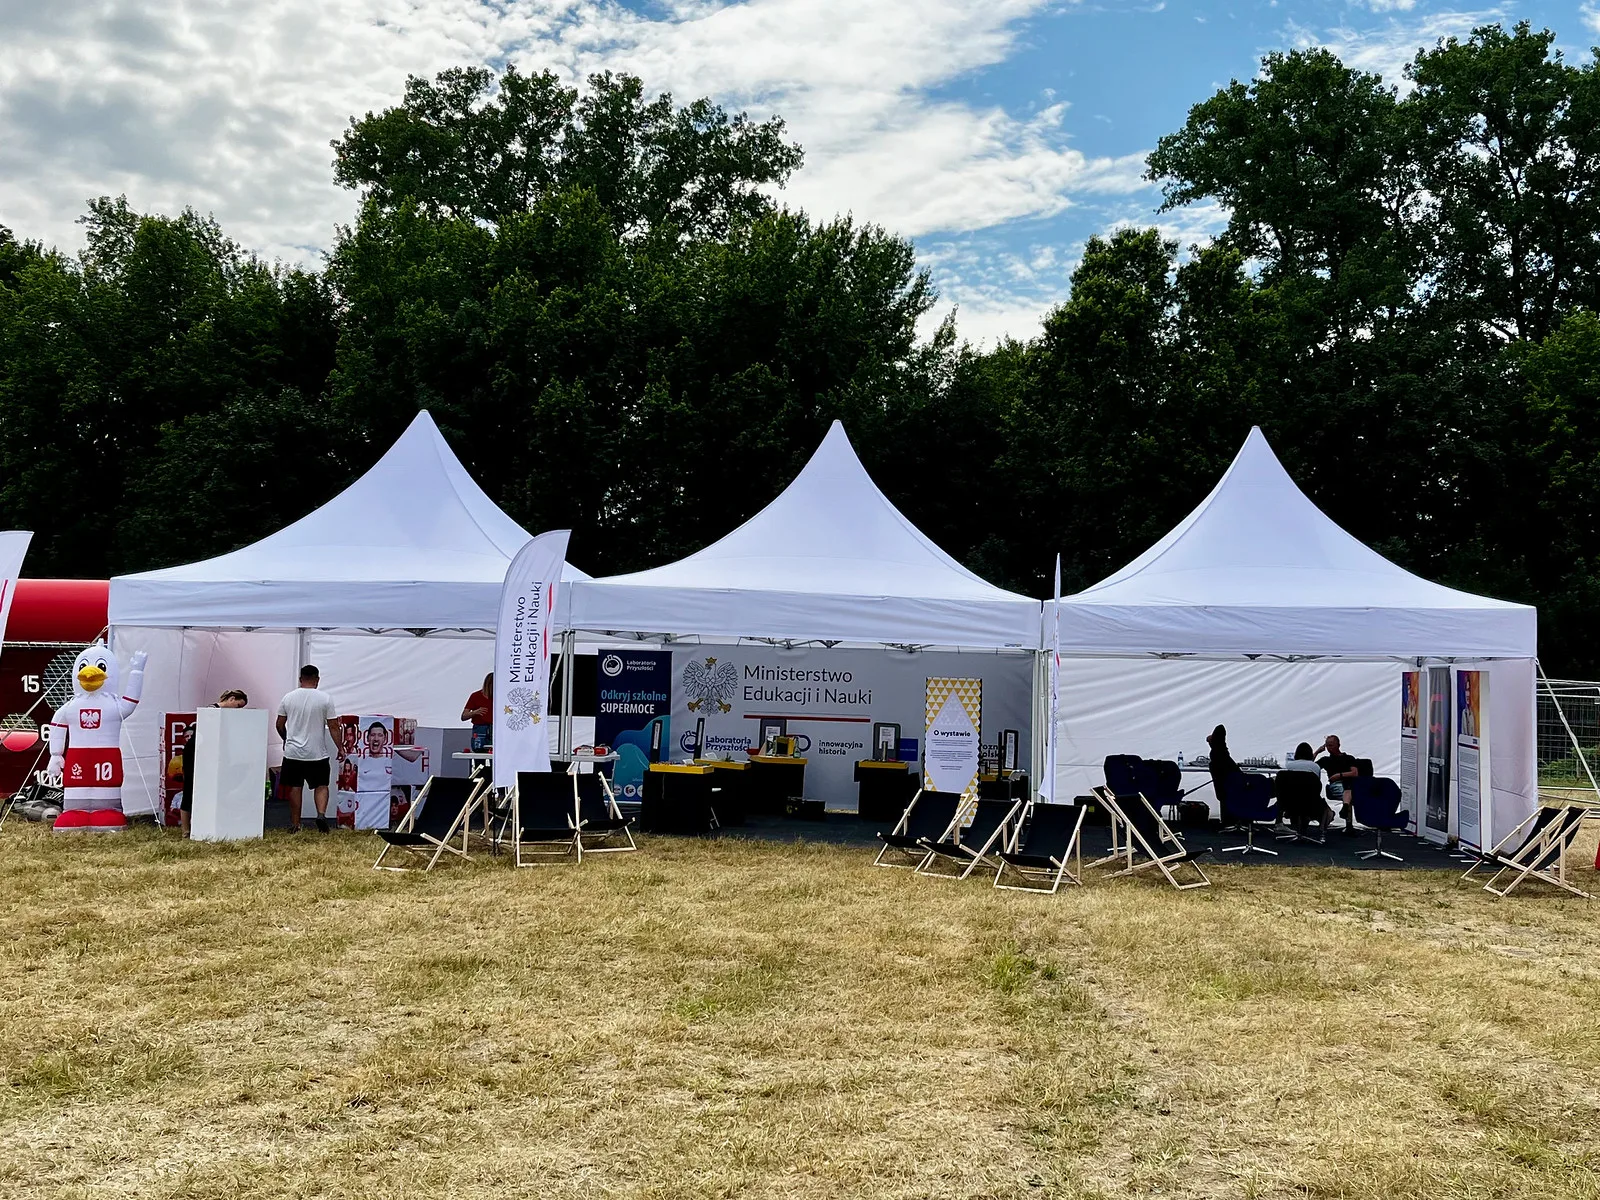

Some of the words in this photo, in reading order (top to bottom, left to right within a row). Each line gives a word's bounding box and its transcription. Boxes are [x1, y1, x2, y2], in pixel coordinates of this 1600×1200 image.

[527, 581, 543, 619] Nauki
[509, 596, 526, 683] Ministerstwo
[524, 628, 540, 683] Edukacji
[744, 664, 853, 683] Ministerstwo
[21, 674, 40, 693] 15
[600, 689, 631, 703] Odkryj
[632, 690, 667, 702] szkolne
[743, 686, 812, 706] Edukacji
[815, 687, 820, 703] i
[824, 688, 873, 705] Nauki
[600, 702, 655, 714] SUPERMOCE
[705, 735, 752, 745] Laboratoria
[818, 740, 864, 749] innowacyjna
[818, 748, 847, 756] historia
[94, 761, 113, 782] 10
